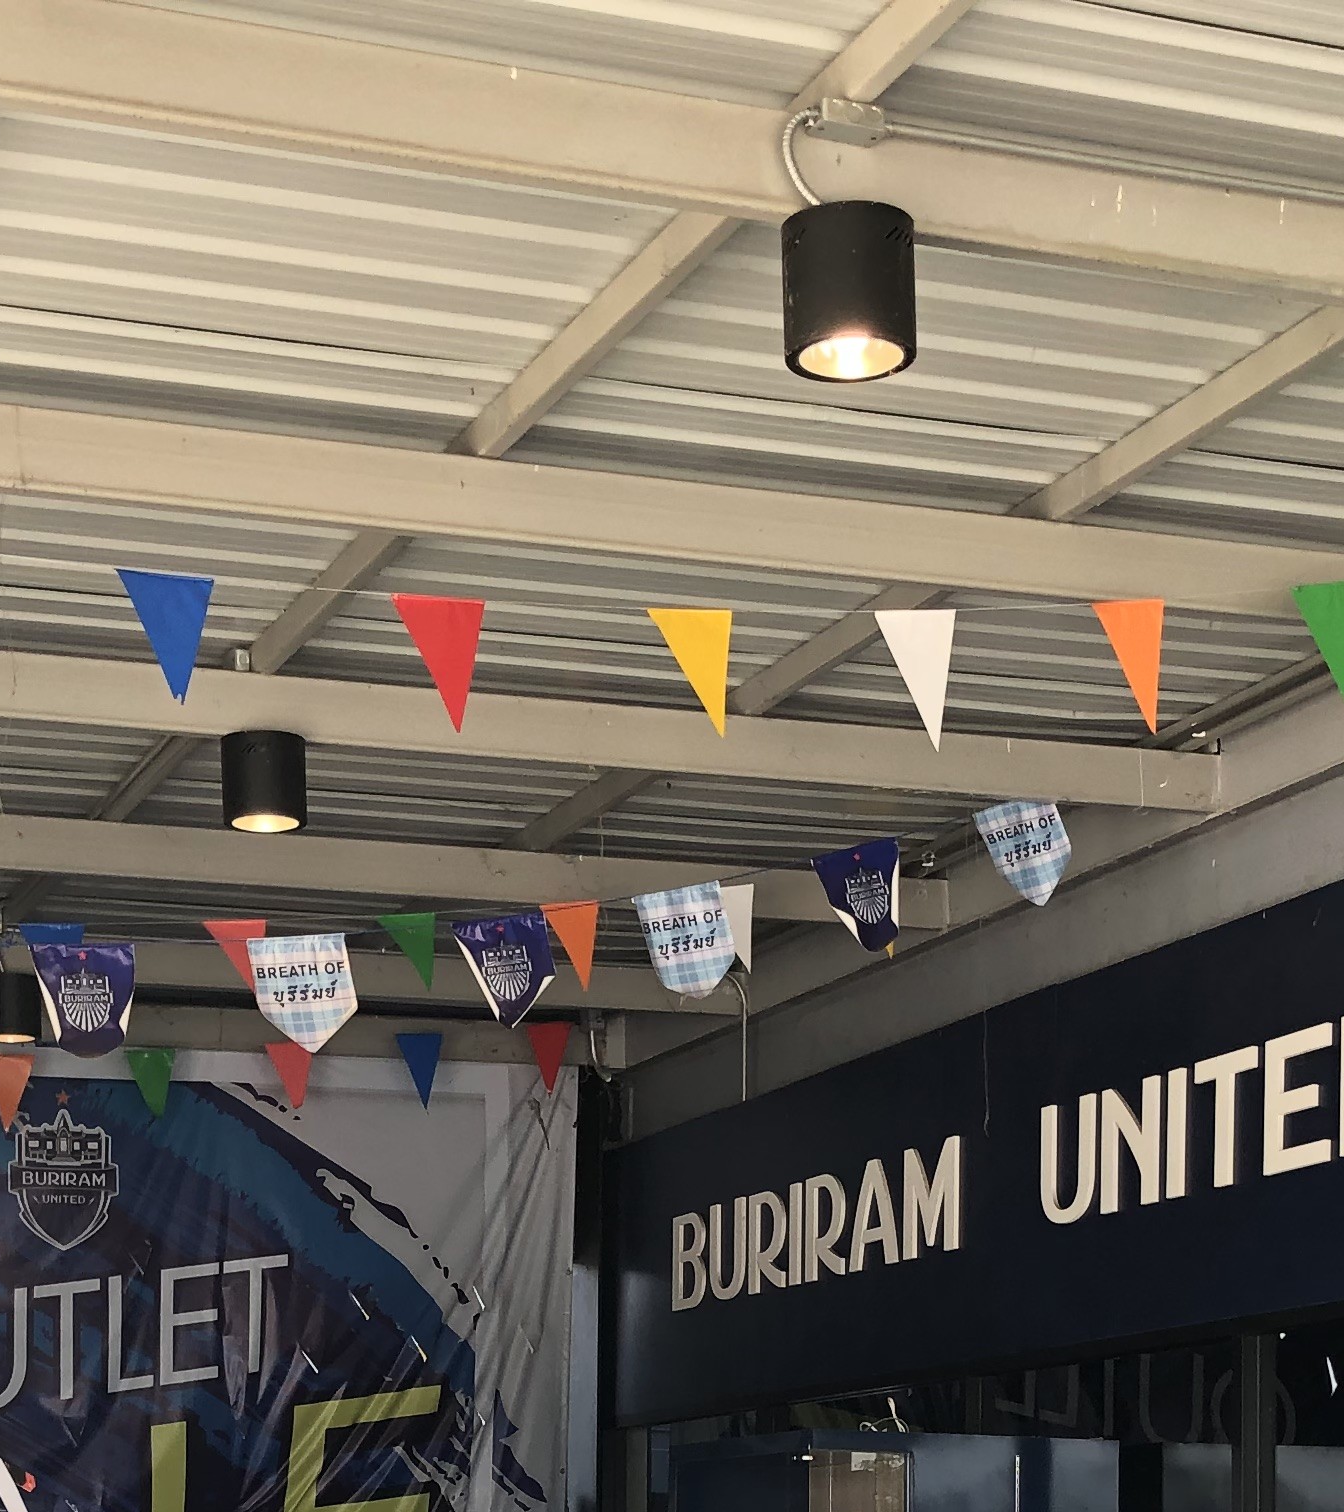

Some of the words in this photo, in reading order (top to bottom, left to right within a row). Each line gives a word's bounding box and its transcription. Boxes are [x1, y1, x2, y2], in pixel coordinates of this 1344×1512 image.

[986, 820, 1035, 845] BREATH
[1038, 813, 1056, 829] OF
[642, 914, 698, 935] BREATH
[703, 909, 723, 924] OF
[256, 963, 319, 979] BREATH
[324, 961, 344, 975] OF
[64, 994, 109, 1004] BURIRAM
[22, 1171, 106, 1187] BURIRAM
[42, 1194, 86, 1205] UNITED
[670, 1134, 965, 1312] BURIRAM
